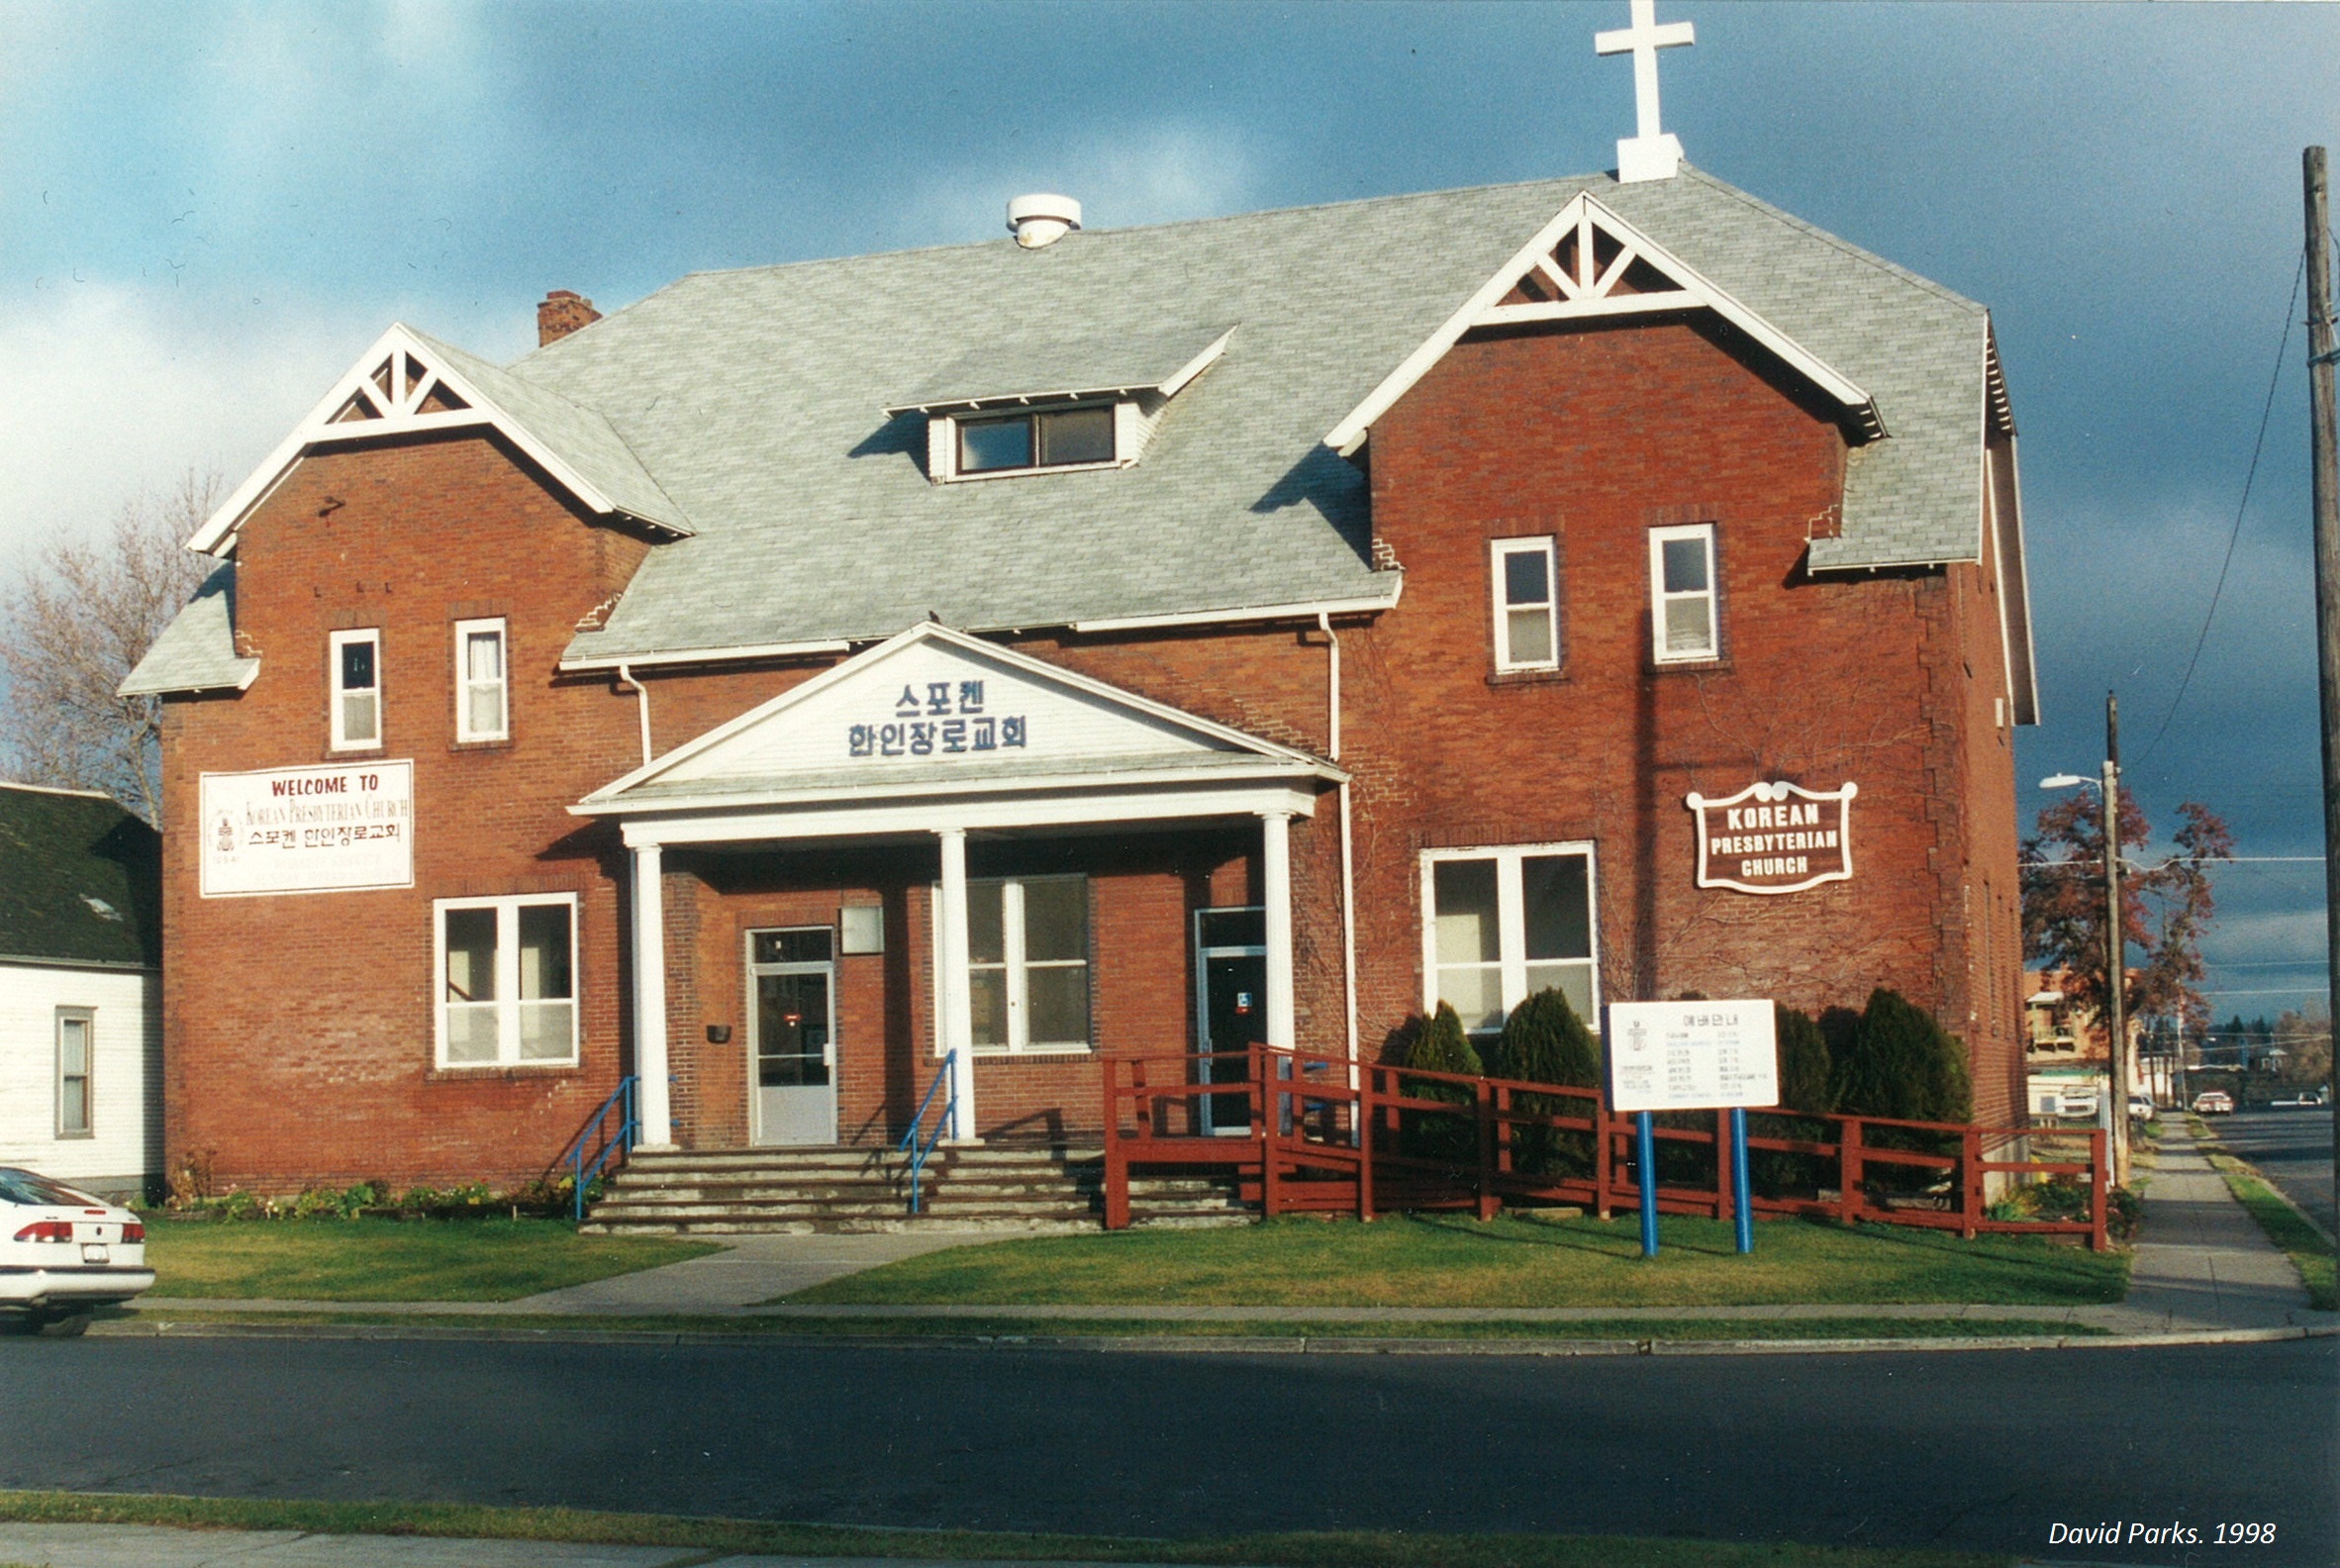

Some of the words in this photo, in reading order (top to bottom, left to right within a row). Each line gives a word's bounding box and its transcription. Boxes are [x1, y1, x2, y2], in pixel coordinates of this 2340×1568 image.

[896, 680, 984, 718] 스포켄
[849, 715, 1026, 757] 한인장로교회
[271, 776, 347, 797] WELCOME
[359, 774, 379, 791] TO
[1727, 803, 1819, 830] KOREAN
[1710, 831, 1837, 855] PRESBYTERIAN
[1741, 856, 1808, 876] CHURCH
